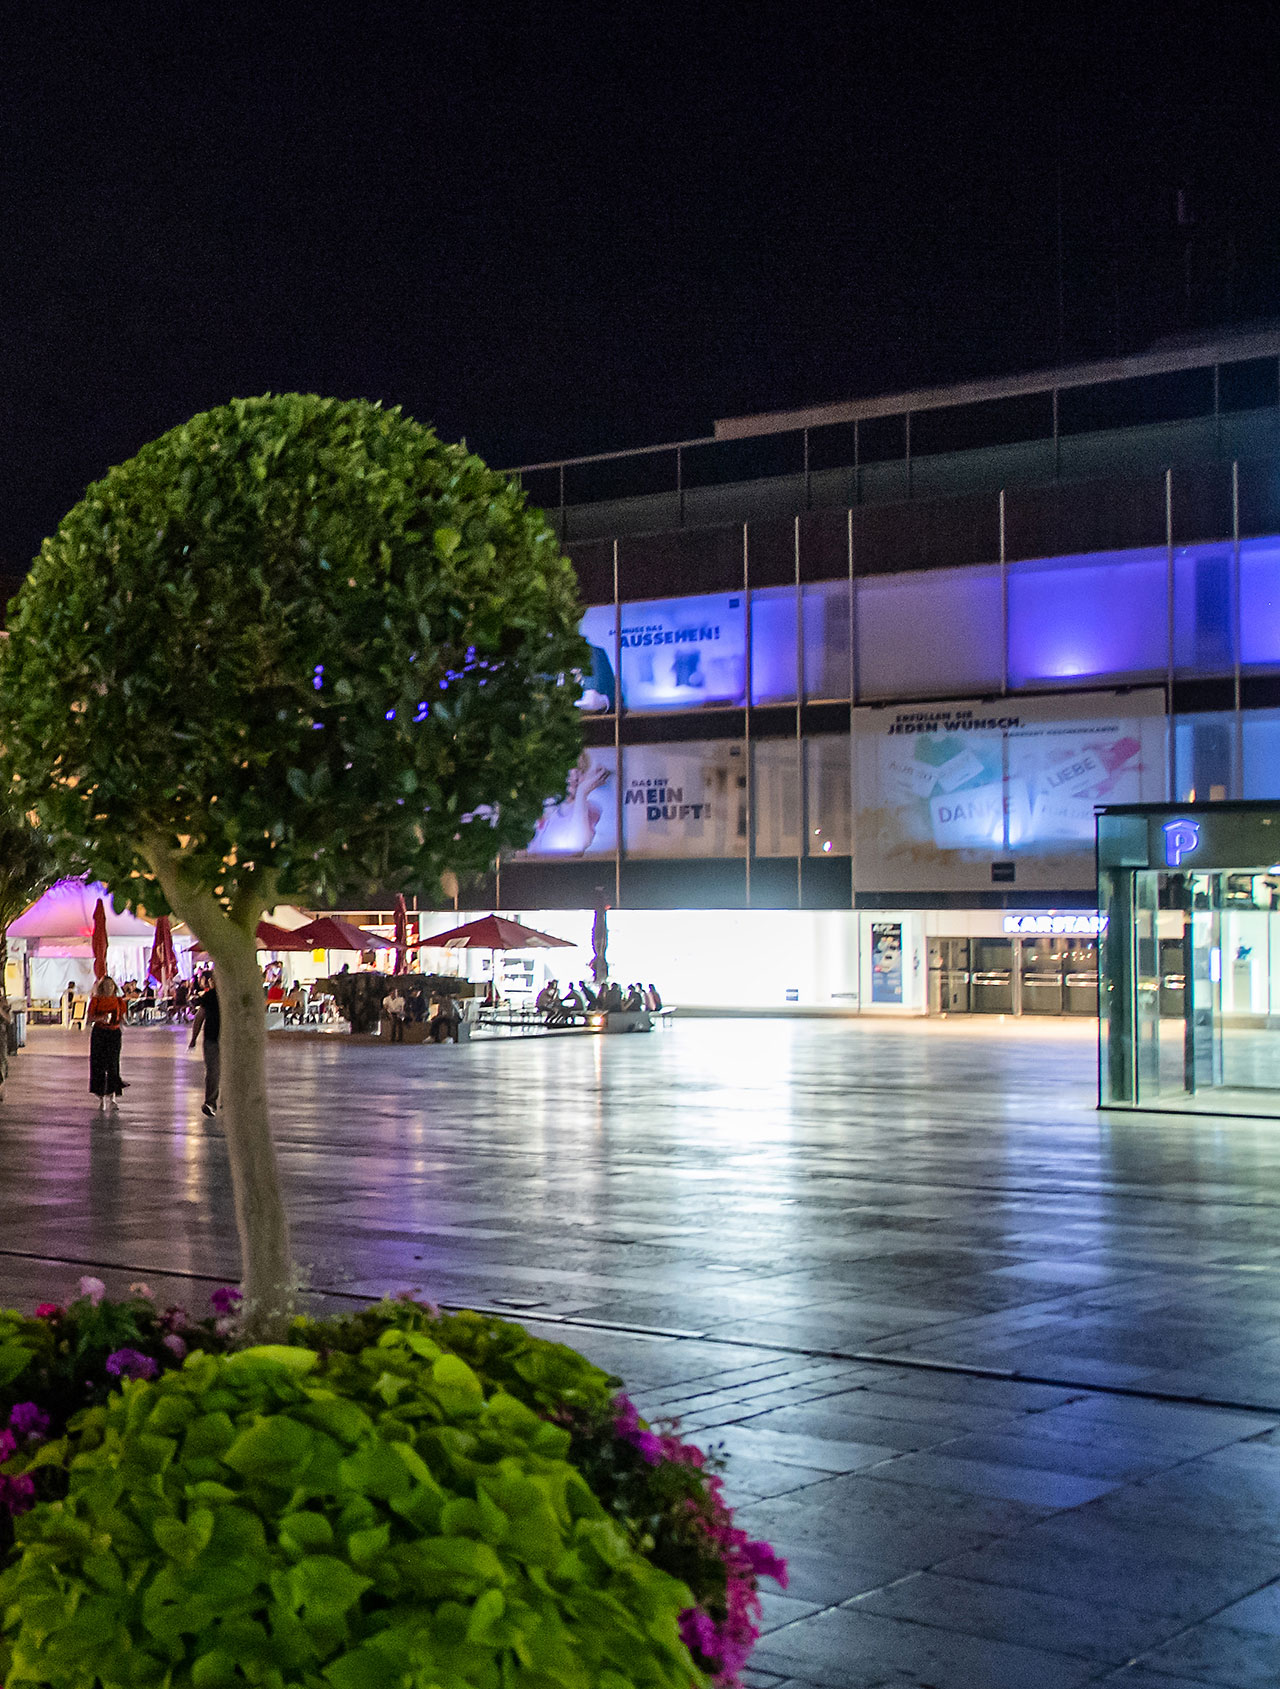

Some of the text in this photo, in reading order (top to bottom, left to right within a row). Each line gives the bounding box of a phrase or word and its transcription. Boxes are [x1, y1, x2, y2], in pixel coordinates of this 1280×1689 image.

[620, 625, 720, 648] AUSSEHEN!
[888, 722, 938, 735] JEDEN
[1046, 755, 1097, 788] LIEBE
[625, 787, 683, 804] MEIN
[647, 803, 711, 821] DUFT!
[1163, 821, 1199, 867] P
